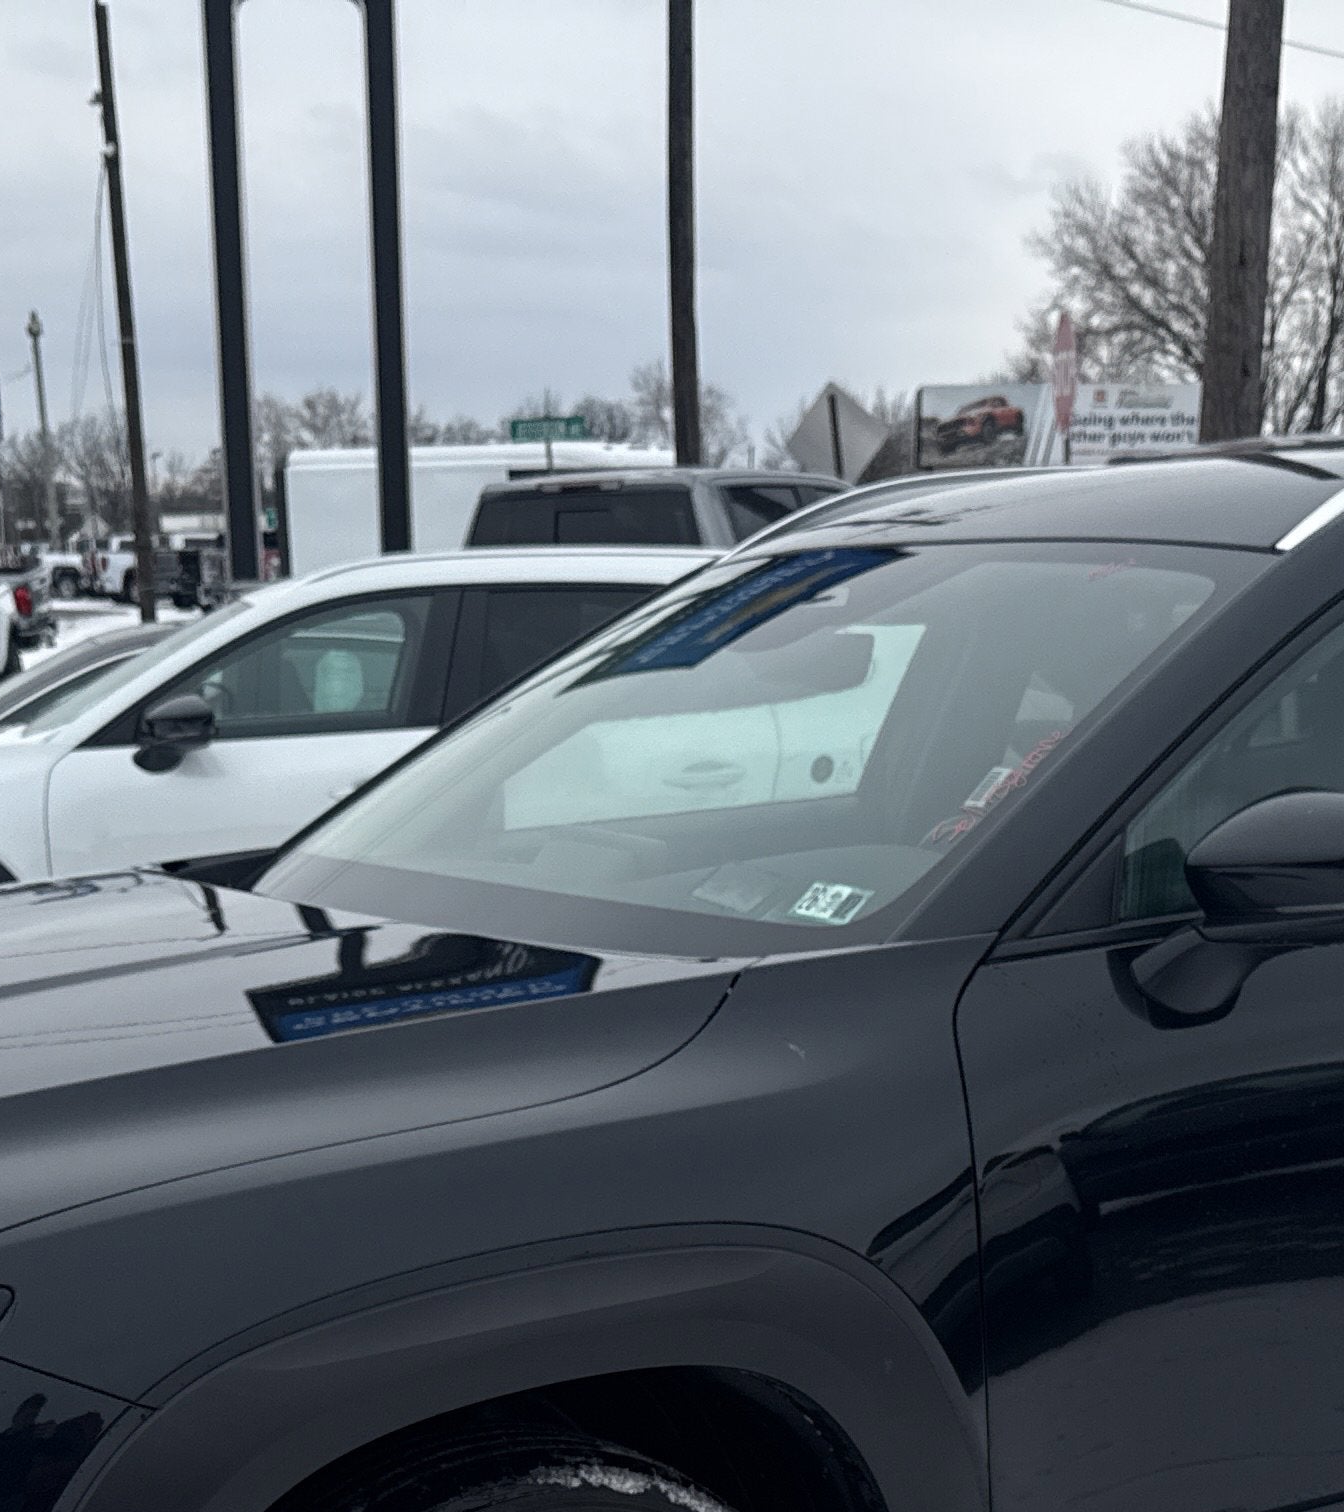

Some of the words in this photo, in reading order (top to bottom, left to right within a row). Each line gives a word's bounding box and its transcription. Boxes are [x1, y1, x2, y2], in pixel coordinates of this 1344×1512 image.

[1119, 411, 1167, 426] where
[1171, 412, 1196, 426] the
[1109, 431, 1146, 447] guys
